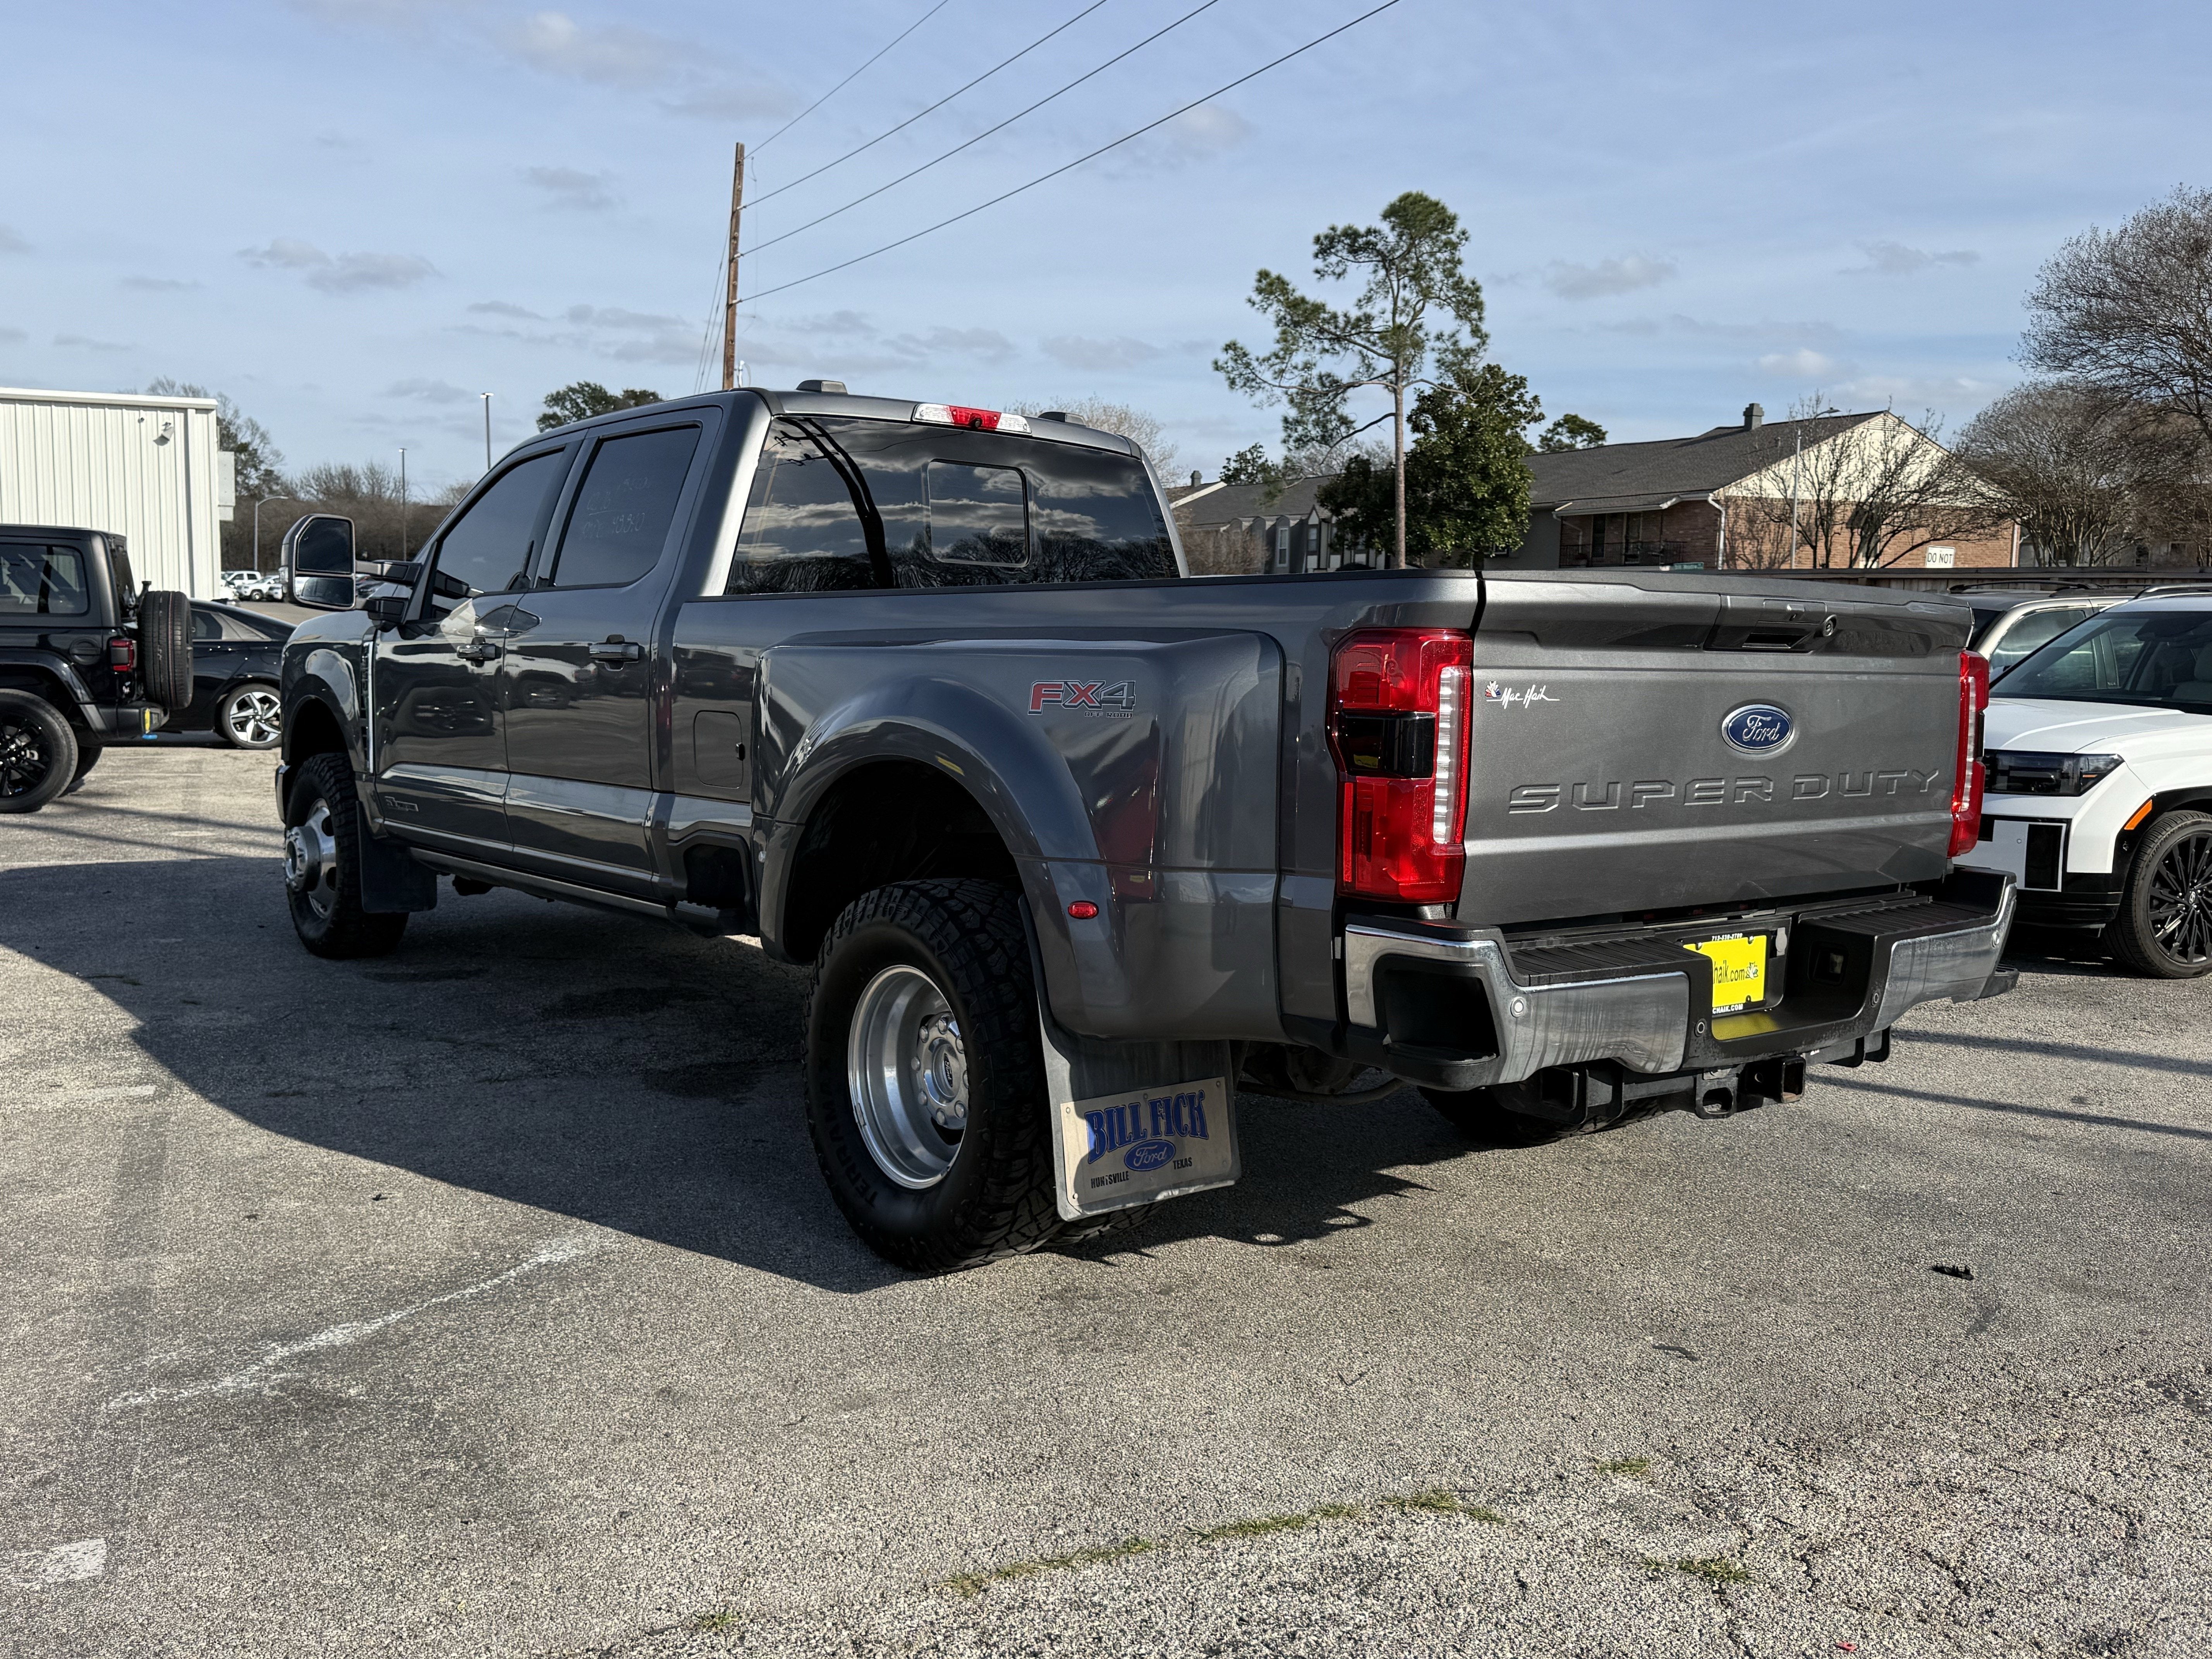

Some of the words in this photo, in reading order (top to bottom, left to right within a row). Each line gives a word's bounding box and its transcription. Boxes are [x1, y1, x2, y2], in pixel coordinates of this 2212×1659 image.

[1927, 553, 1937, 563] DO
[1939, 553, 1953, 564] NOT
[1027, 680, 1136, 716] FX4
[1501, 687, 1523, 709] Mac
[1523, 684, 1558, 709] Haik
[1742, 714, 1781, 742] Ford
[1508, 776, 1773, 814] SUPER
[1792, 768, 1939, 800] DUTY
[1084, 1103, 1147, 1164] BILL
[1149, 1089, 1209, 1140] FICK
[1133, 1145, 1167, 1167] Ford
[1091, 1171, 1130, 1189] HUNTSVILLE
[1173, 1157, 1193, 1170] TEXAS
